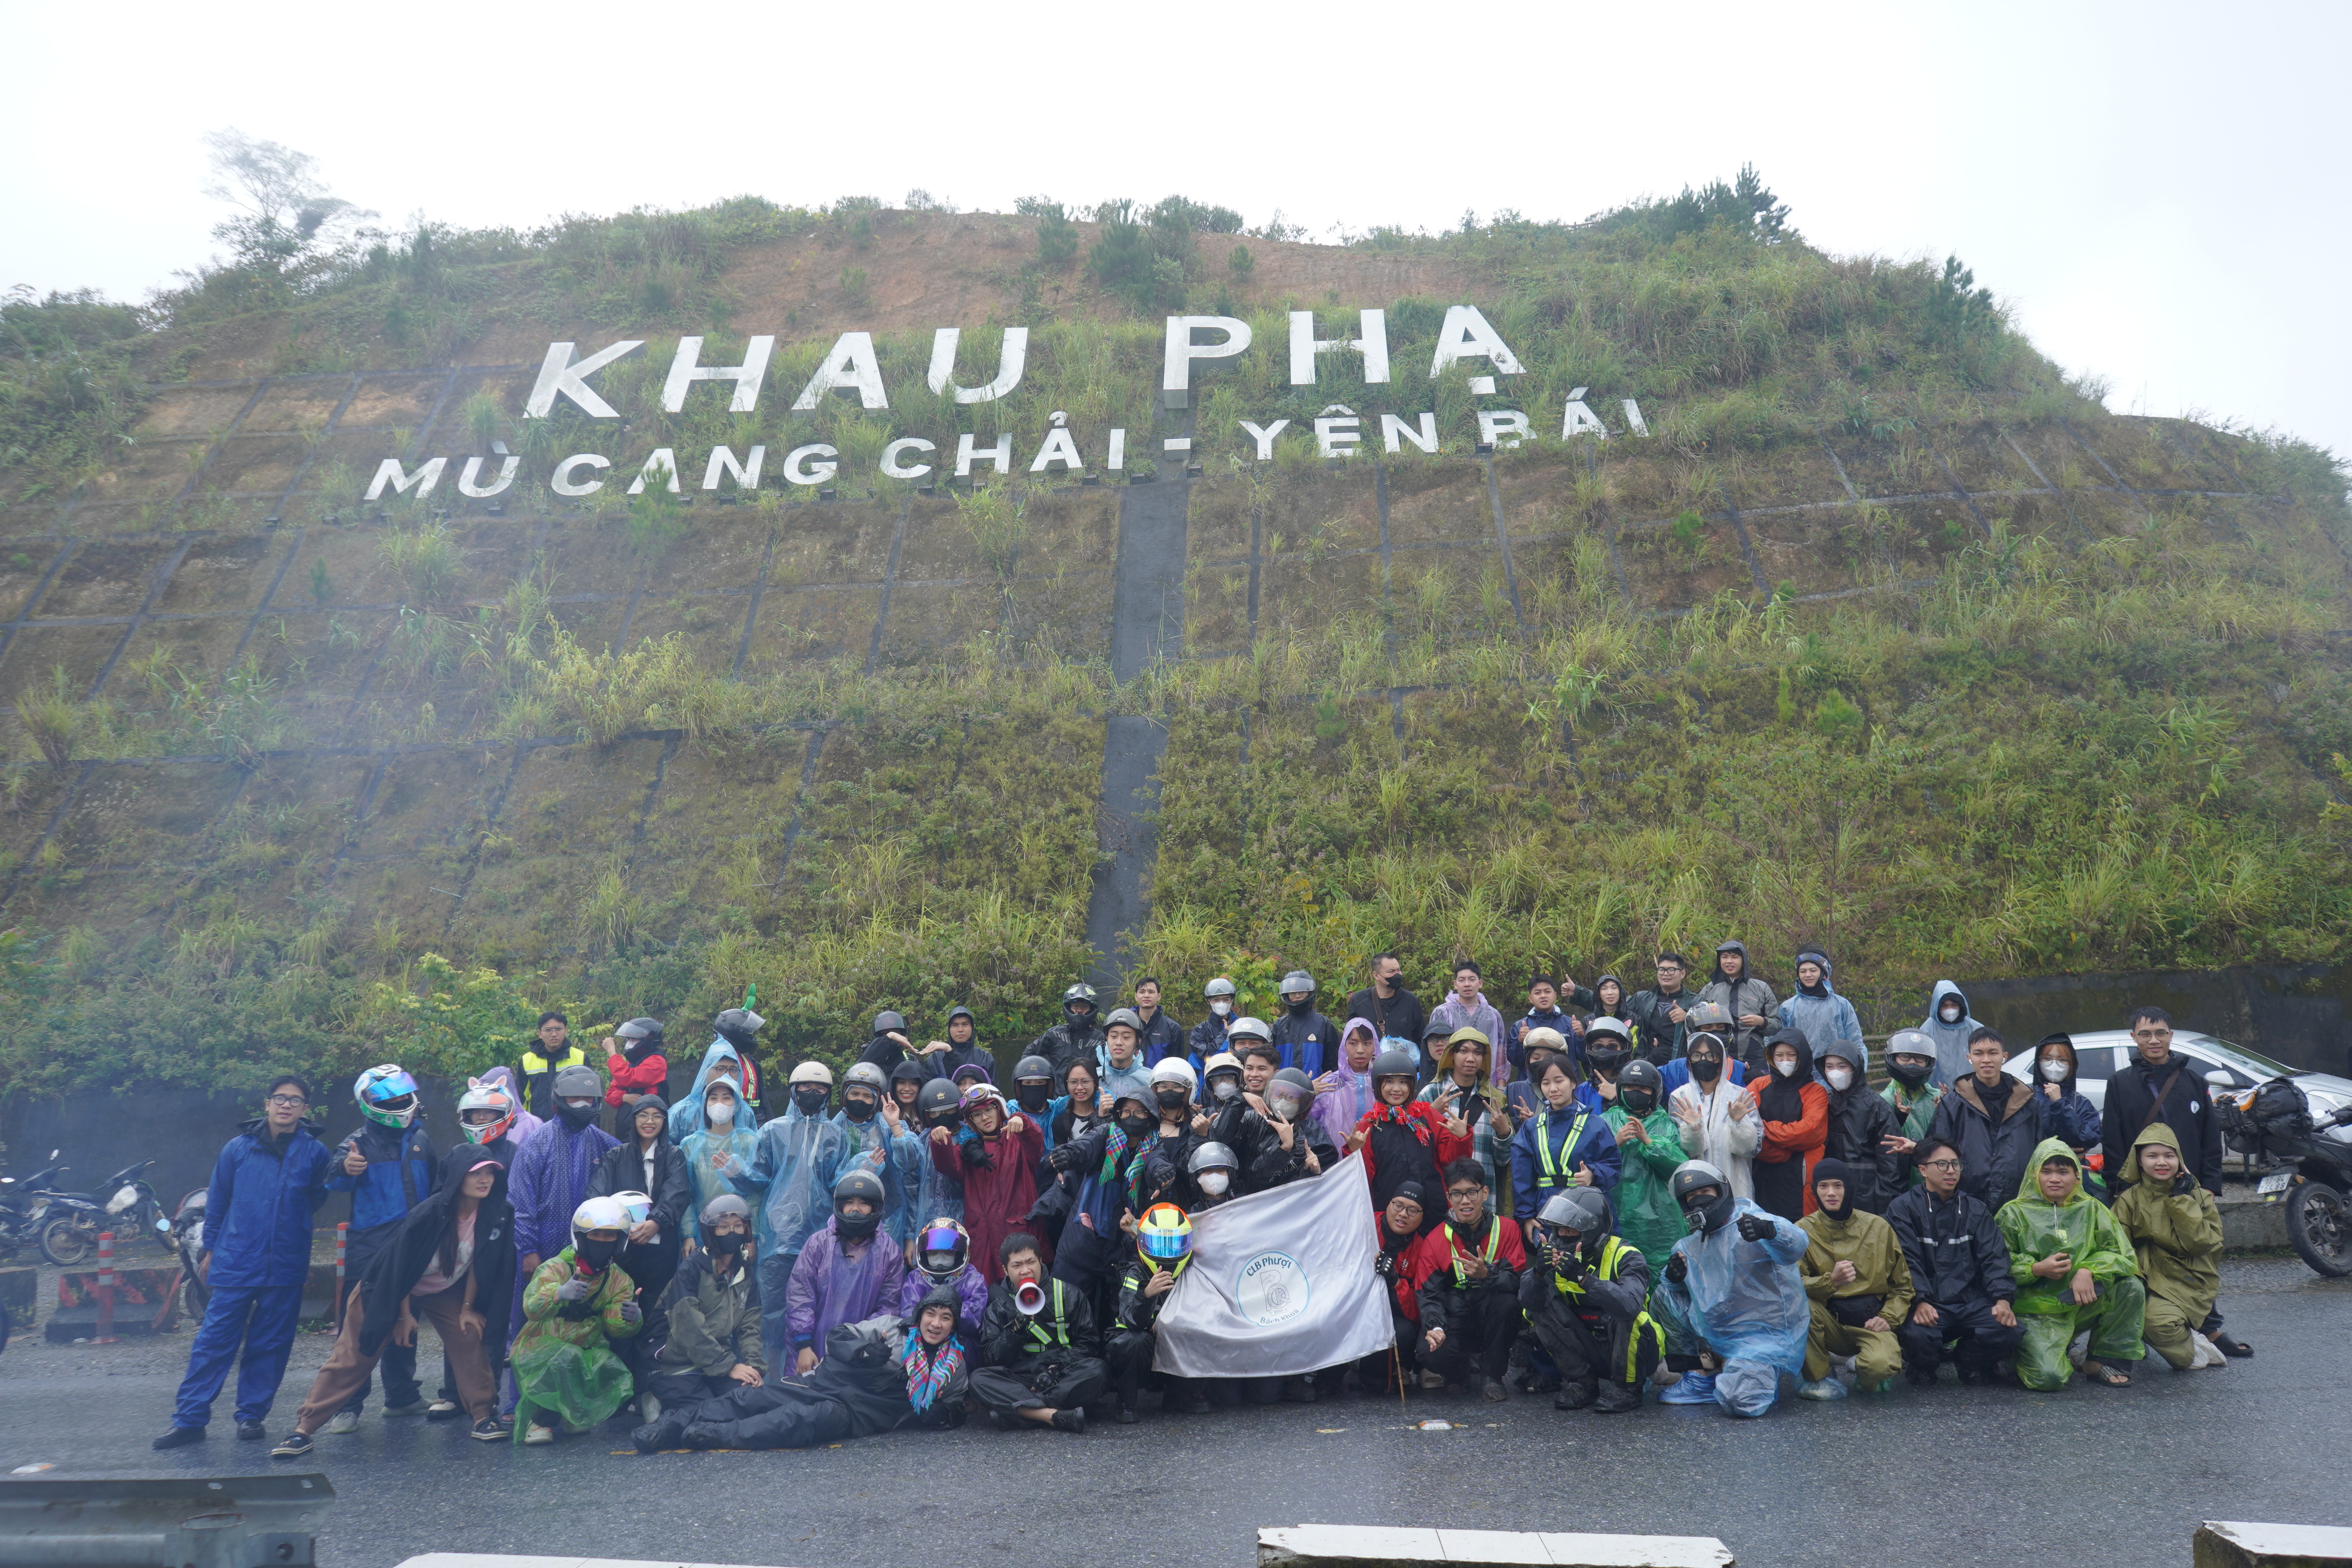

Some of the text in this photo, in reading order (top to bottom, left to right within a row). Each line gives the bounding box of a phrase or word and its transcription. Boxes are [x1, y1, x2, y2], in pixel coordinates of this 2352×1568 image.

[522, 327, 1028, 418] KHAU
[363, 440, 520, 500] MÙ
[550, 443, 838, 496] CANG
[879, 411, 1125, 479] CHẢI
[1238, 404, 1439, 460] YÊN
[1477, 387, 1649, 448] BÁI
[1247, 1256, 1292, 1276] CLB Phượt
[1281, 1309, 1299, 1321] Khoa
